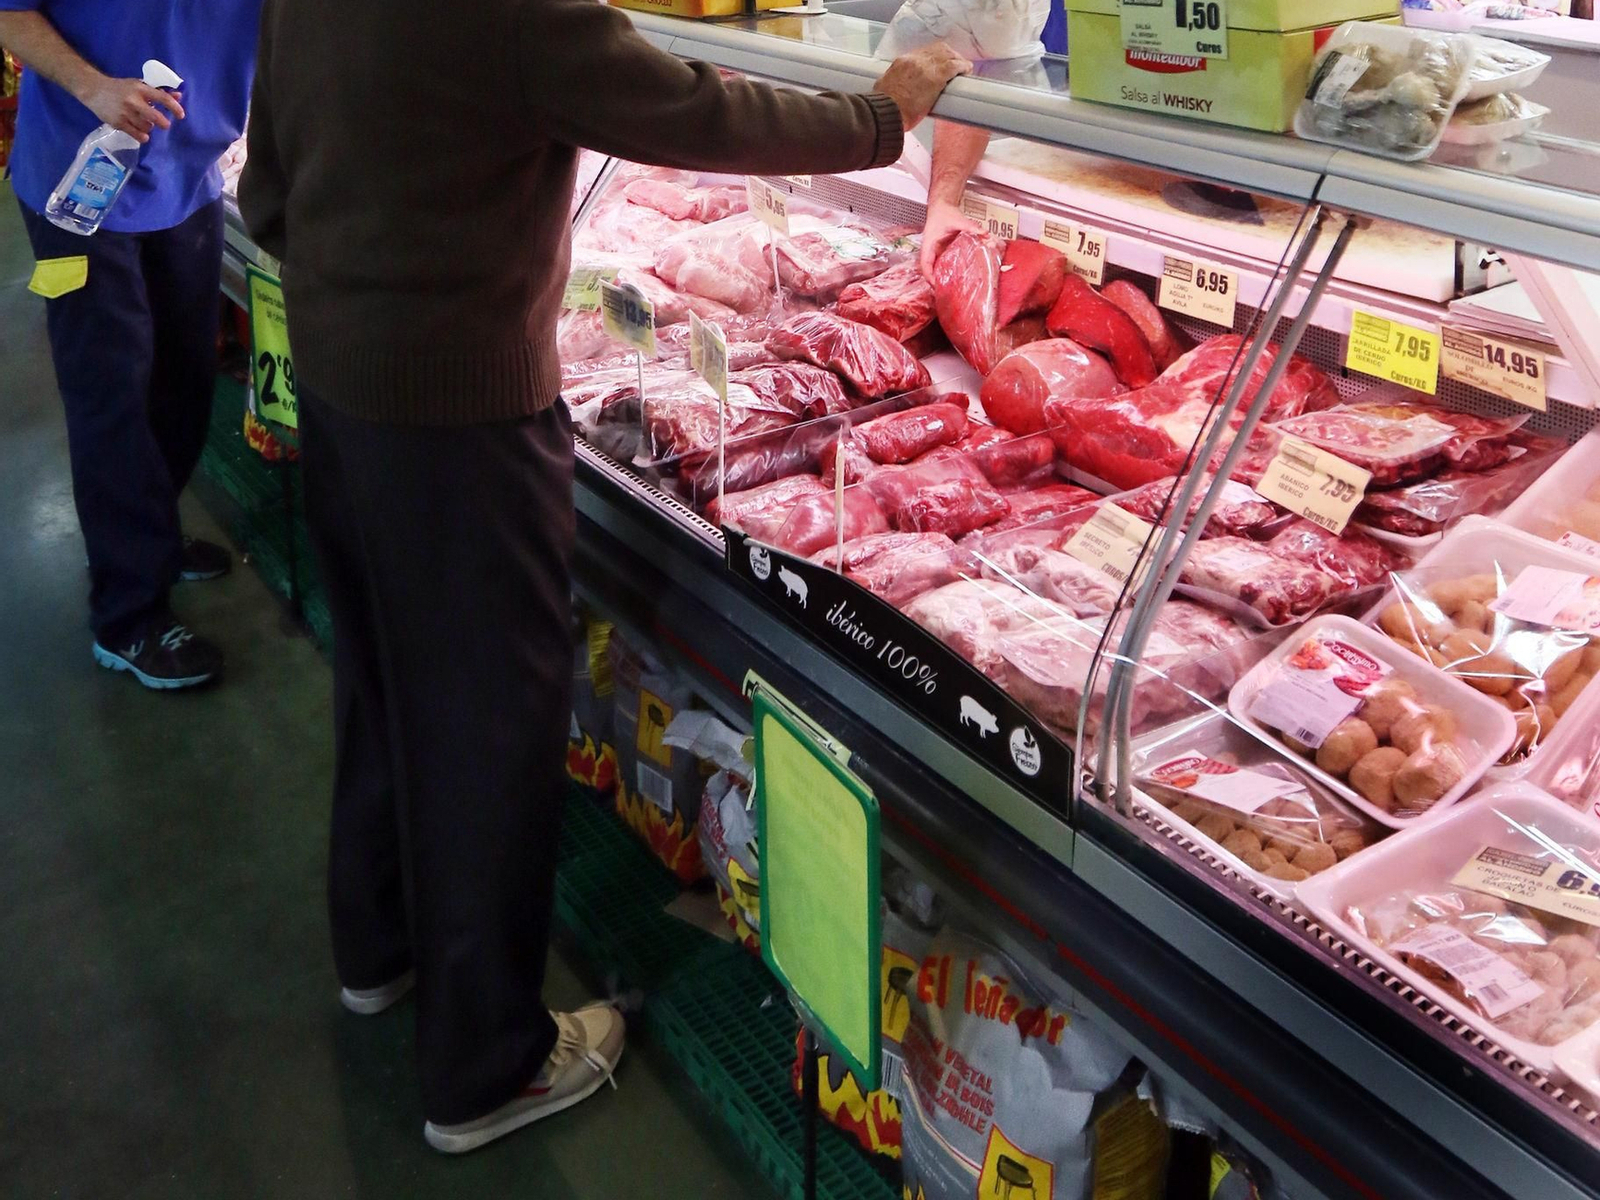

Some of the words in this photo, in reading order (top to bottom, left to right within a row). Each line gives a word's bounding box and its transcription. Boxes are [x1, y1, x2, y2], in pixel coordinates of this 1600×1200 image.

[1121, 85, 1149, 104] Salsa
[1151, 90, 1161, 105] al
[1163, 93, 1213, 113] WHISKY
[988, 219, 1014, 240] 10,95
[1076, 231, 1101, 258] 7,95
[1196, 268, 1228, 295] 6,95
[1395, 331, 1431, 362] 7,95
[1484, 344, 1539, 379] 14,95
[1280, 473, 1310, 491] ABANICO
[1320, 473, 1357, 503] 7,95
[825, 600, 876, 651] ibérico
[877, 640, 939, 695] 100%
[1478, 865, 1543, 887] CROQUETAS
[1545, 885, 1561, 894] DE
[917, 954, 951, 1010] El
